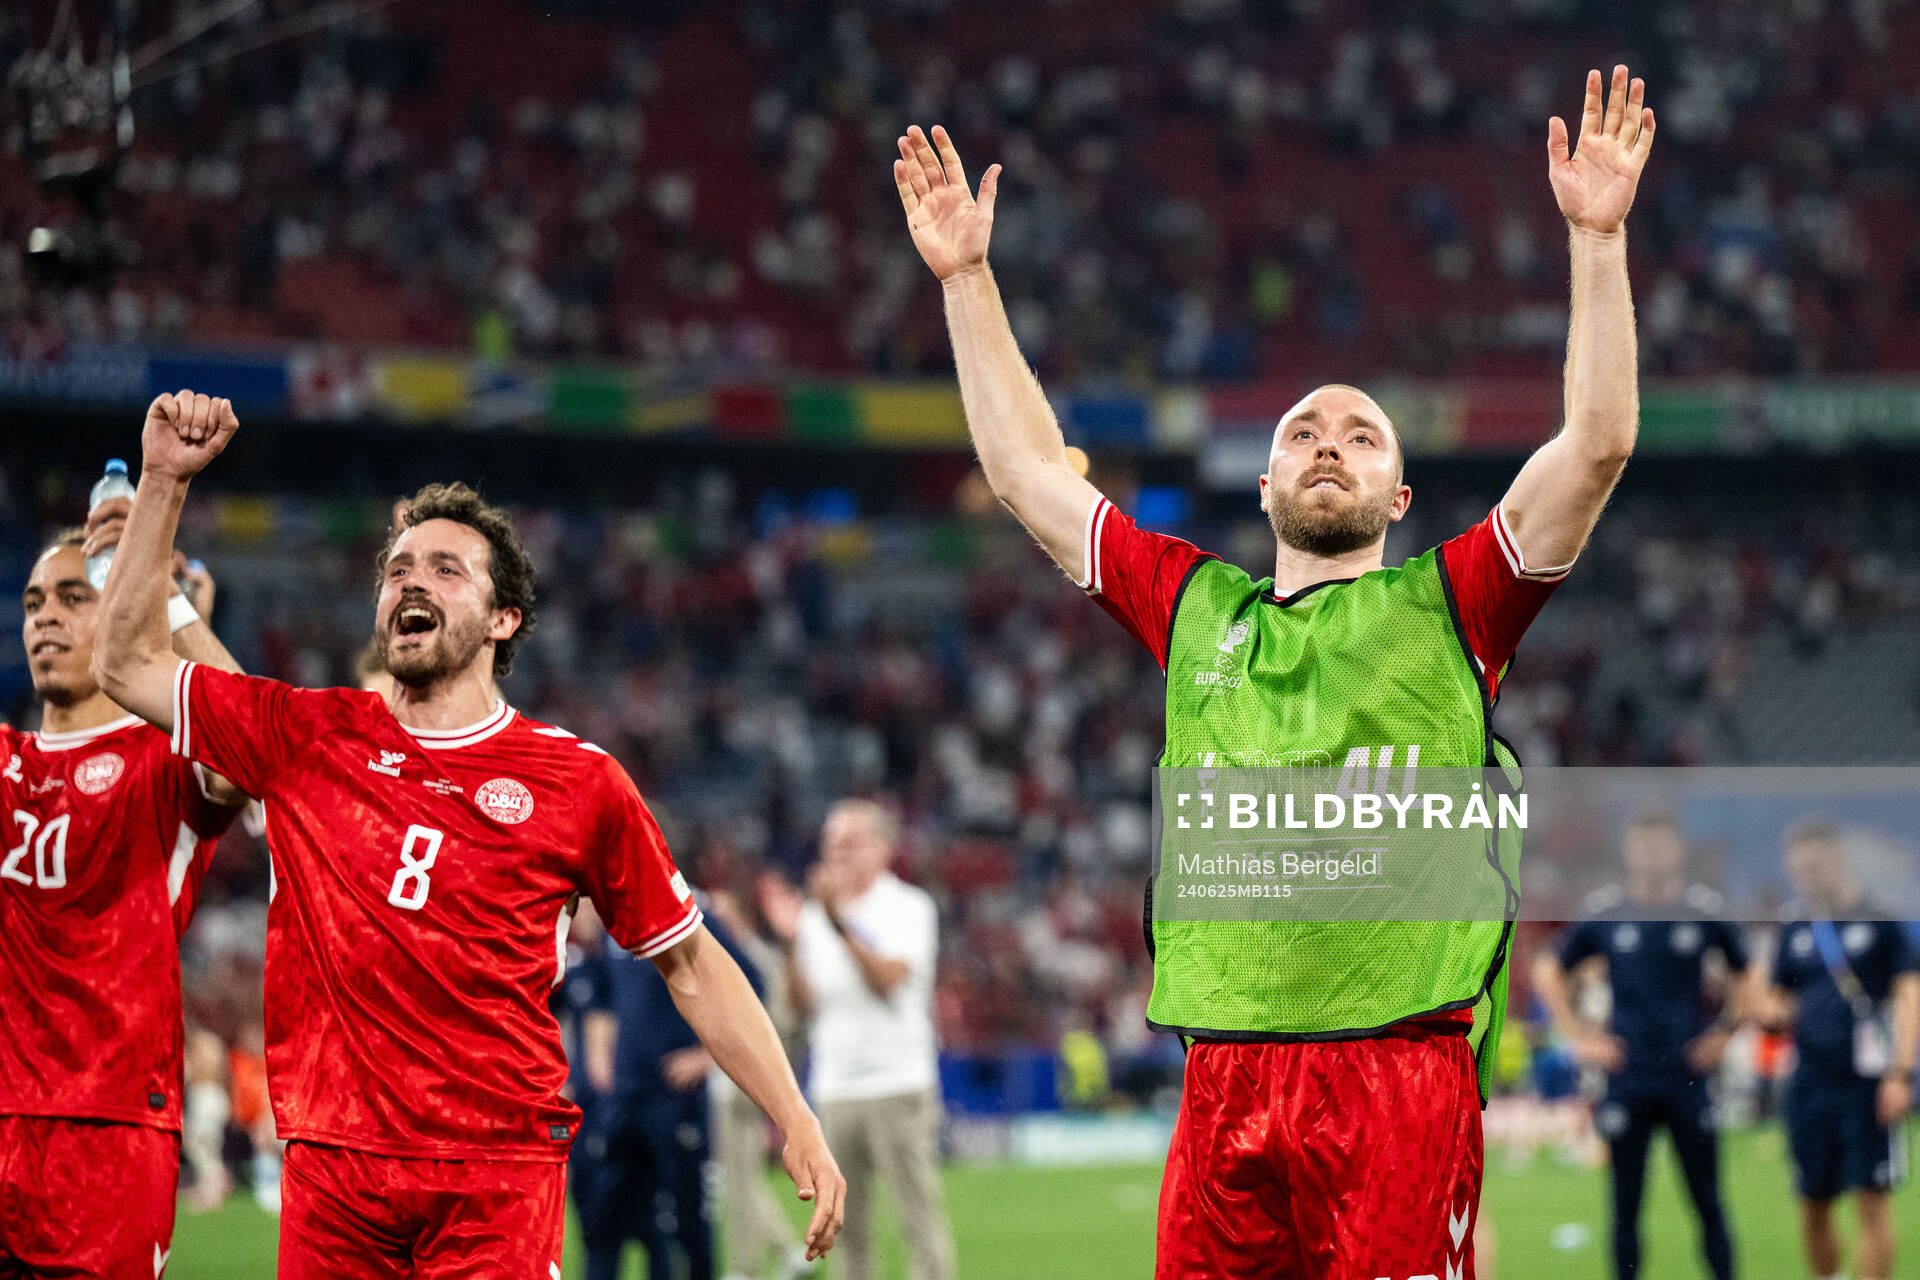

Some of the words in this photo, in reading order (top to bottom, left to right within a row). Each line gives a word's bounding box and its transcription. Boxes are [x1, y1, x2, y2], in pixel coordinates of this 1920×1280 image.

[487, 792, 522, 811] DBU
[0, 808, 71, 890] 20
[387, 823, 444, 911] 8
